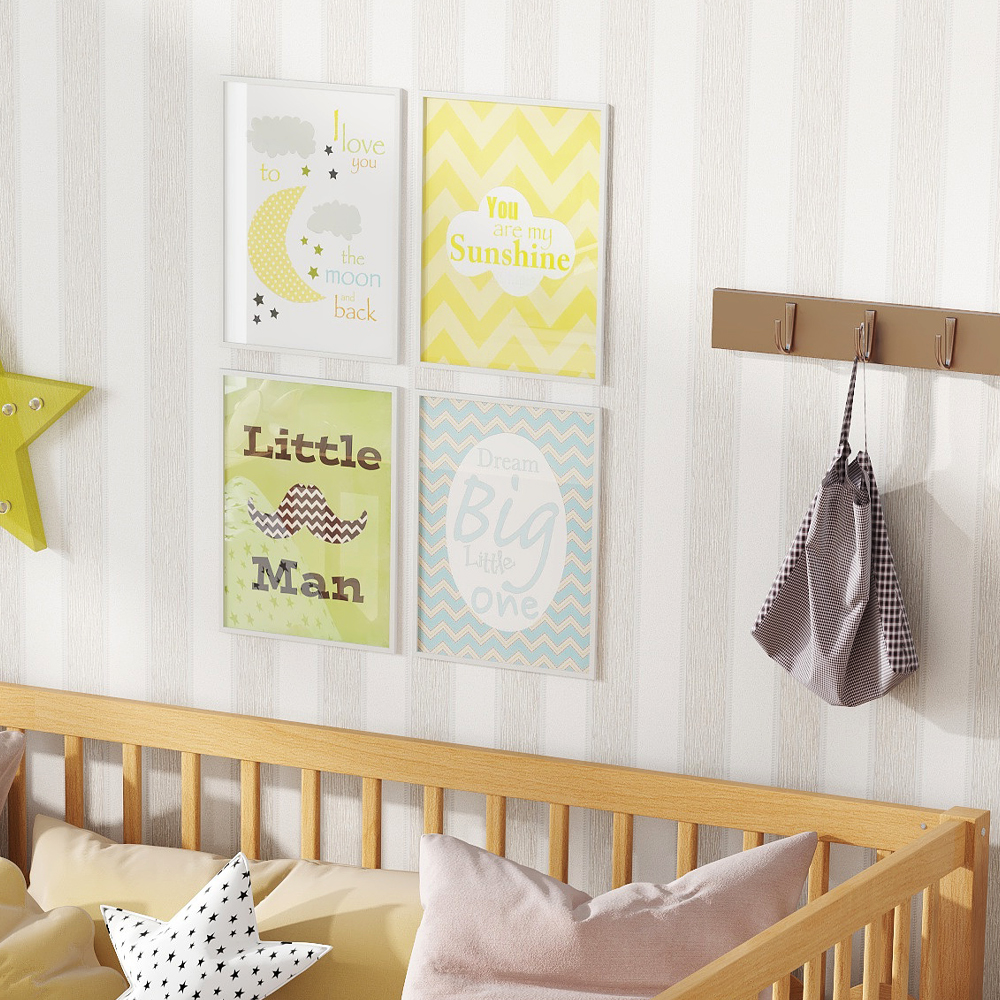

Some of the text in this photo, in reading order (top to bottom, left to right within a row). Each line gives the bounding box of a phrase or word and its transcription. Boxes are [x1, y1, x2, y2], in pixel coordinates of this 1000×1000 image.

[333, 109, 386, 155] I love
[260, 163, 281, 182] to
[350, 157, 377, 174] you
[486, 196, 519, 220] You
[493, 223, 552, 250] are my
[341, 245, 365, 266] the
[450, 233, 571, 272] Sunshine
[325, 269, 381, 288] moon
[333, 294, 377, 322] back
[341, 291, 356, 302] and
[243, 424, 382, 471] Little
[476, 447, 540, 473] Dream
[453, 474, 560, 594] Big
[463, 544, 516, 575] Little
[251, 556, 365, 604] Man
